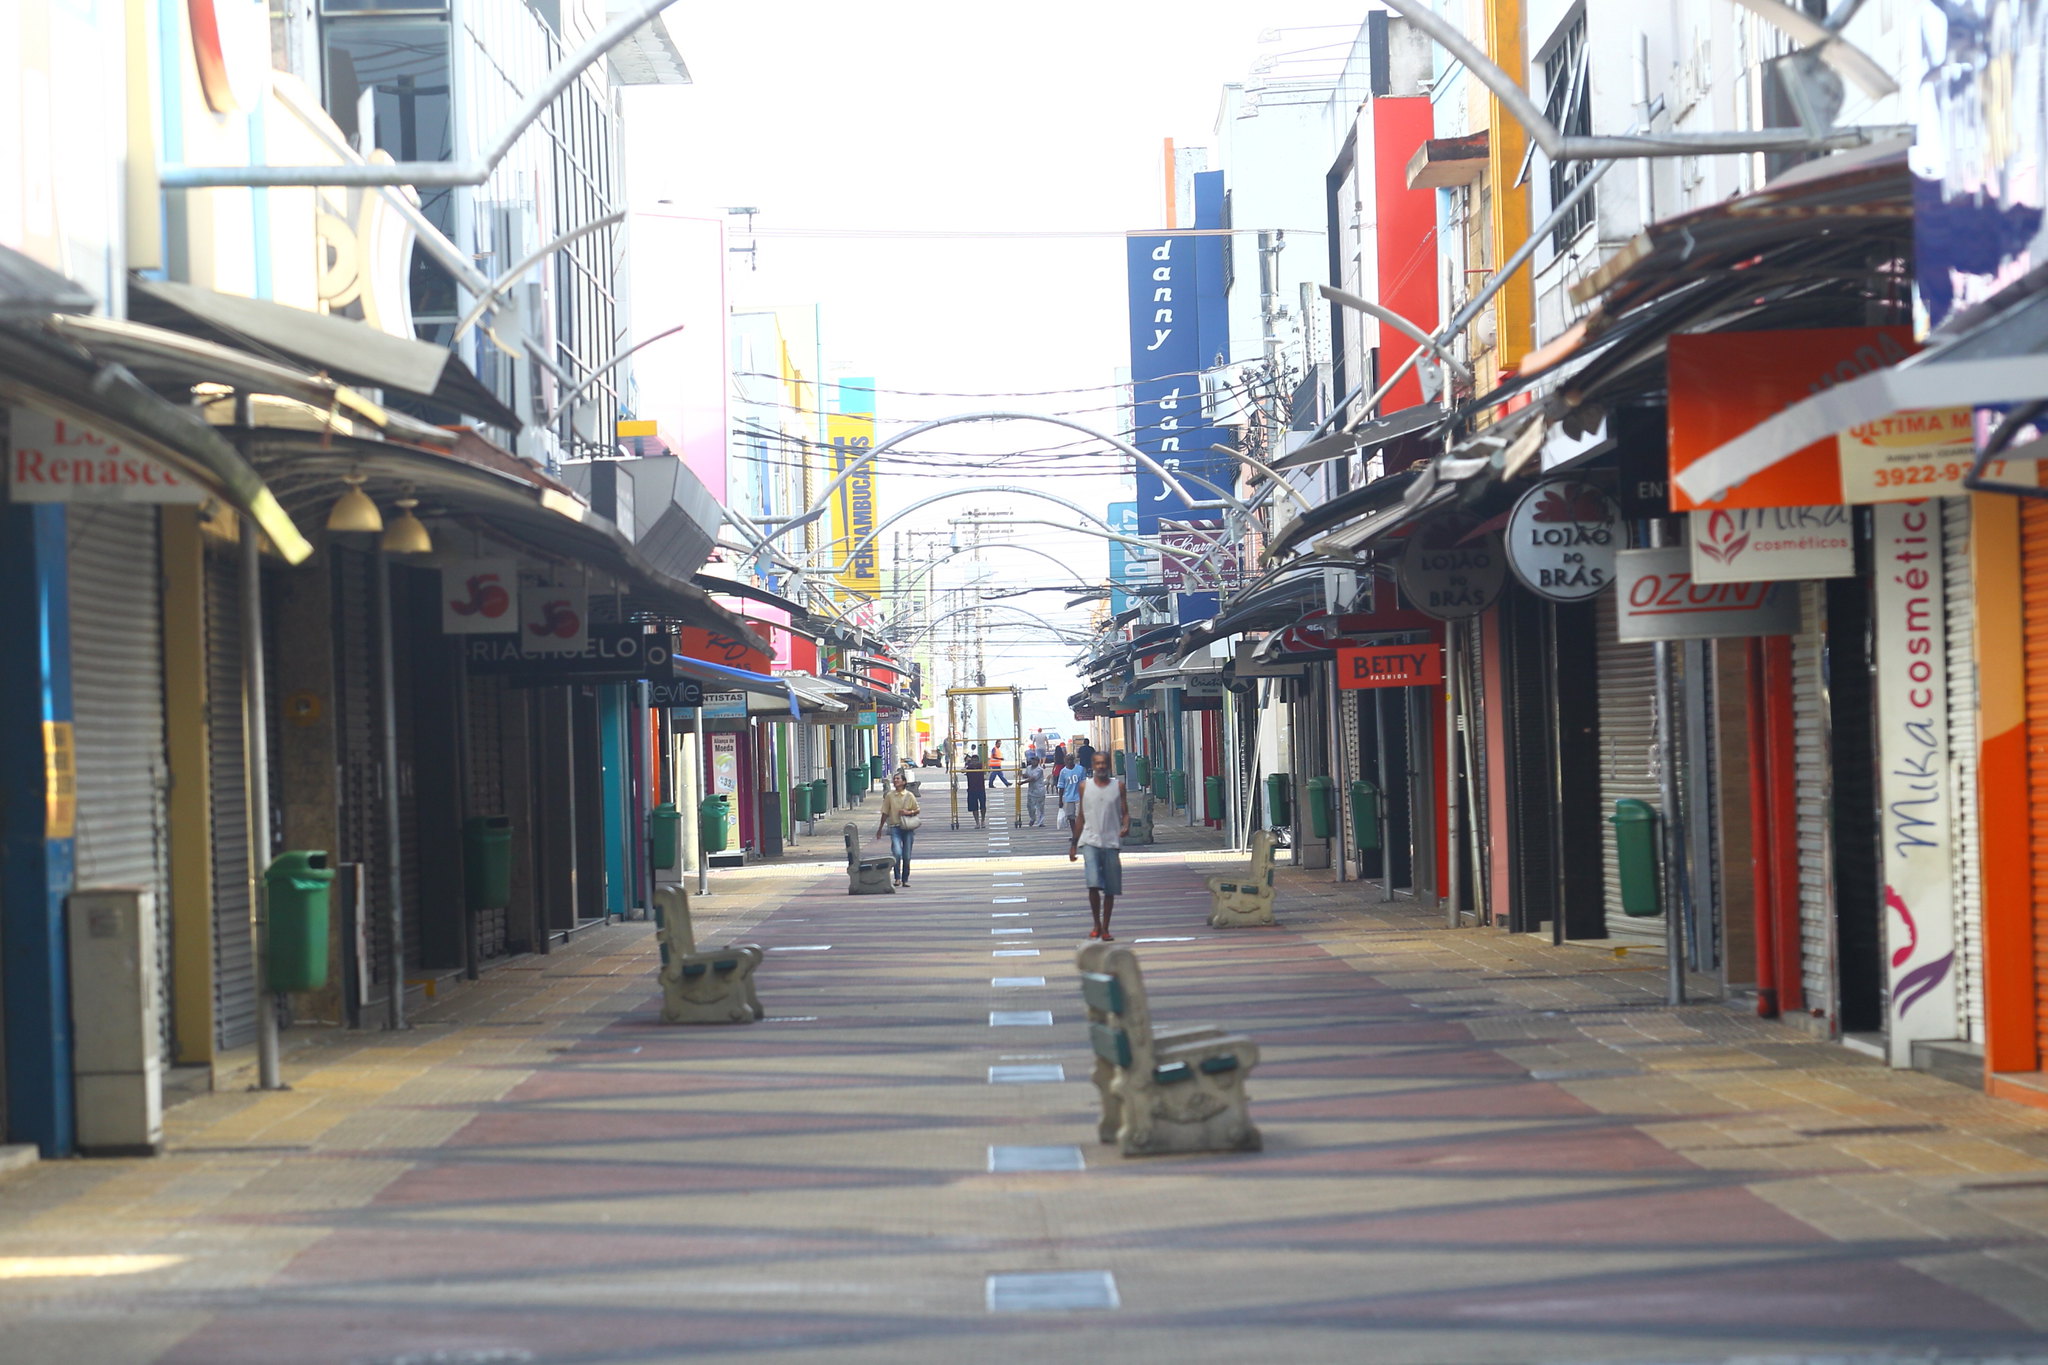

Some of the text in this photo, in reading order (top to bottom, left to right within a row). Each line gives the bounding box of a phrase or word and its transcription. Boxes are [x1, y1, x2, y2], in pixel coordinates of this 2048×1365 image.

[1147, 240, 1172, 351] danny
[1154, 388, 1181, 501] danny
[1754, 536, 1848, 552] cosméticos
[1563, 552, 1584, 564] DO
[1540, 566, 1604, 587] BRÁS
[1894, 498, 1933, 708] cosmétic
[1353, 653, 1427, 679] BETTY
[703, 694, 743, 703] NTISTAS
[1887, 718, 1939, 857] Mika
